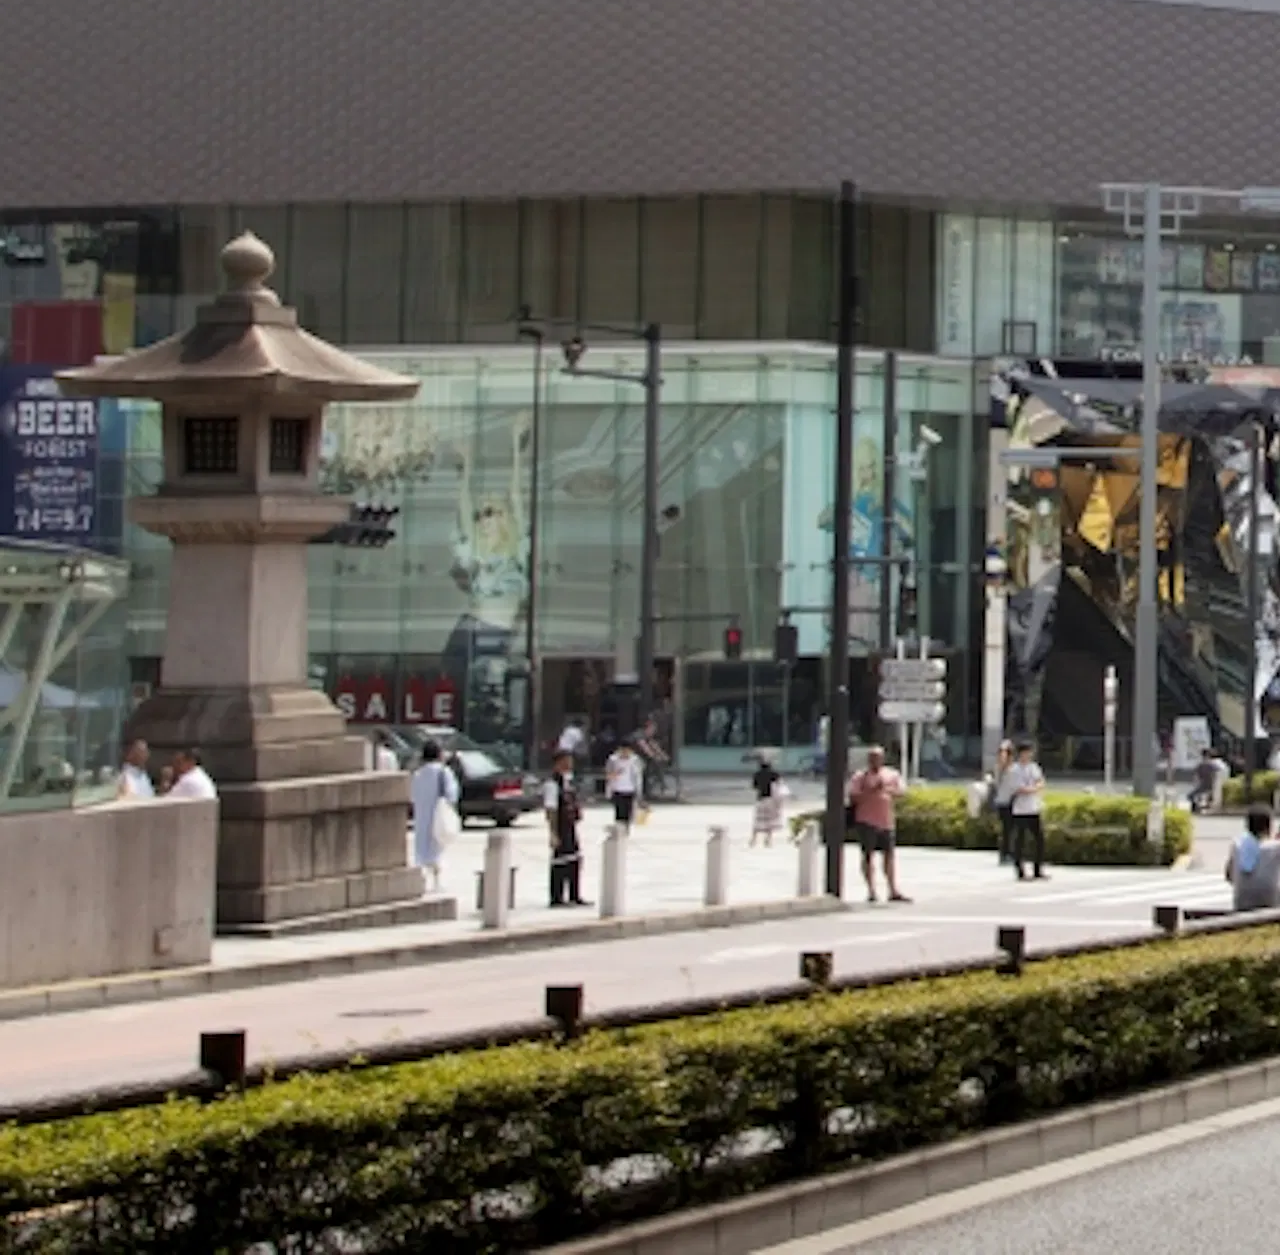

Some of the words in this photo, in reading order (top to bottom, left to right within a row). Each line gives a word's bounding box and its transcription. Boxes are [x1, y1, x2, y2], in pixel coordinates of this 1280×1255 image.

[1101, 347, 1165, 363] TOKU
[1182, 347, 1253, 366] PAZA
[17, 400, 96, 435] BEER
[24, 439, 87, 458] FOREST
[336, 692, 454, 721] SALE
